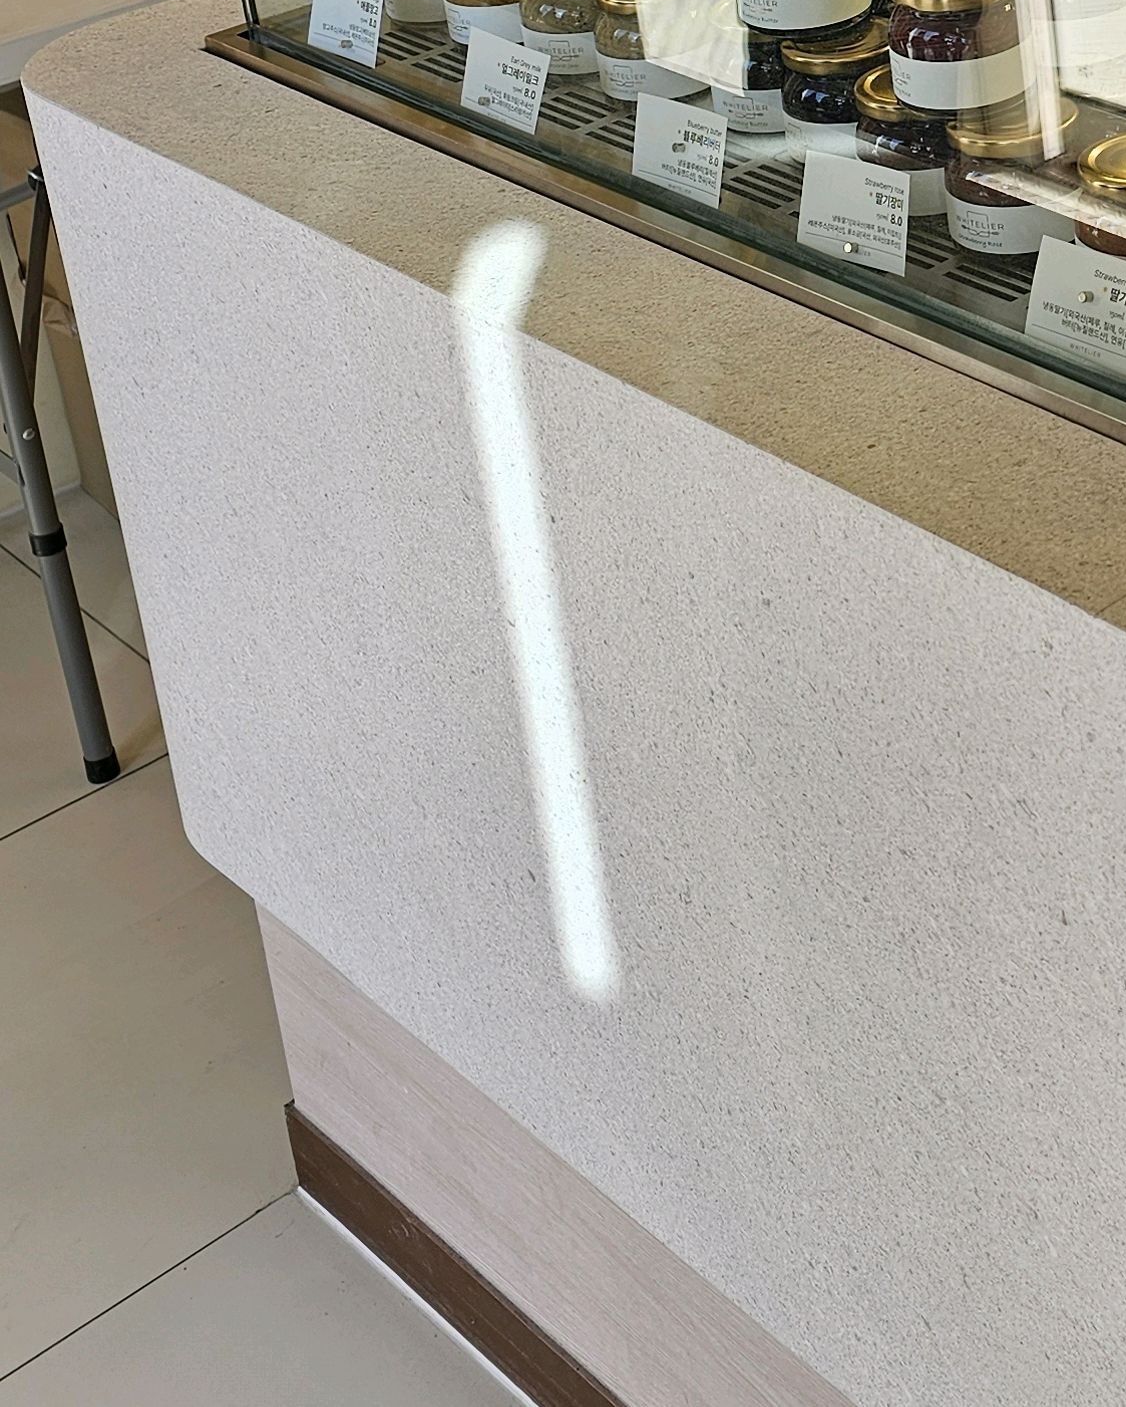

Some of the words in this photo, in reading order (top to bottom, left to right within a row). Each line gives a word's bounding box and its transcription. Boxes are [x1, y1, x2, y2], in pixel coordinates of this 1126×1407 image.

[524, 88, 536, 100] 8.0
[708, 155, 719, 167] 8.0
[865, 177, 894, 193] Strawberry
[875, 192, 904, 212] 딸기장미
[890, 214, 903, 226] 8.0
